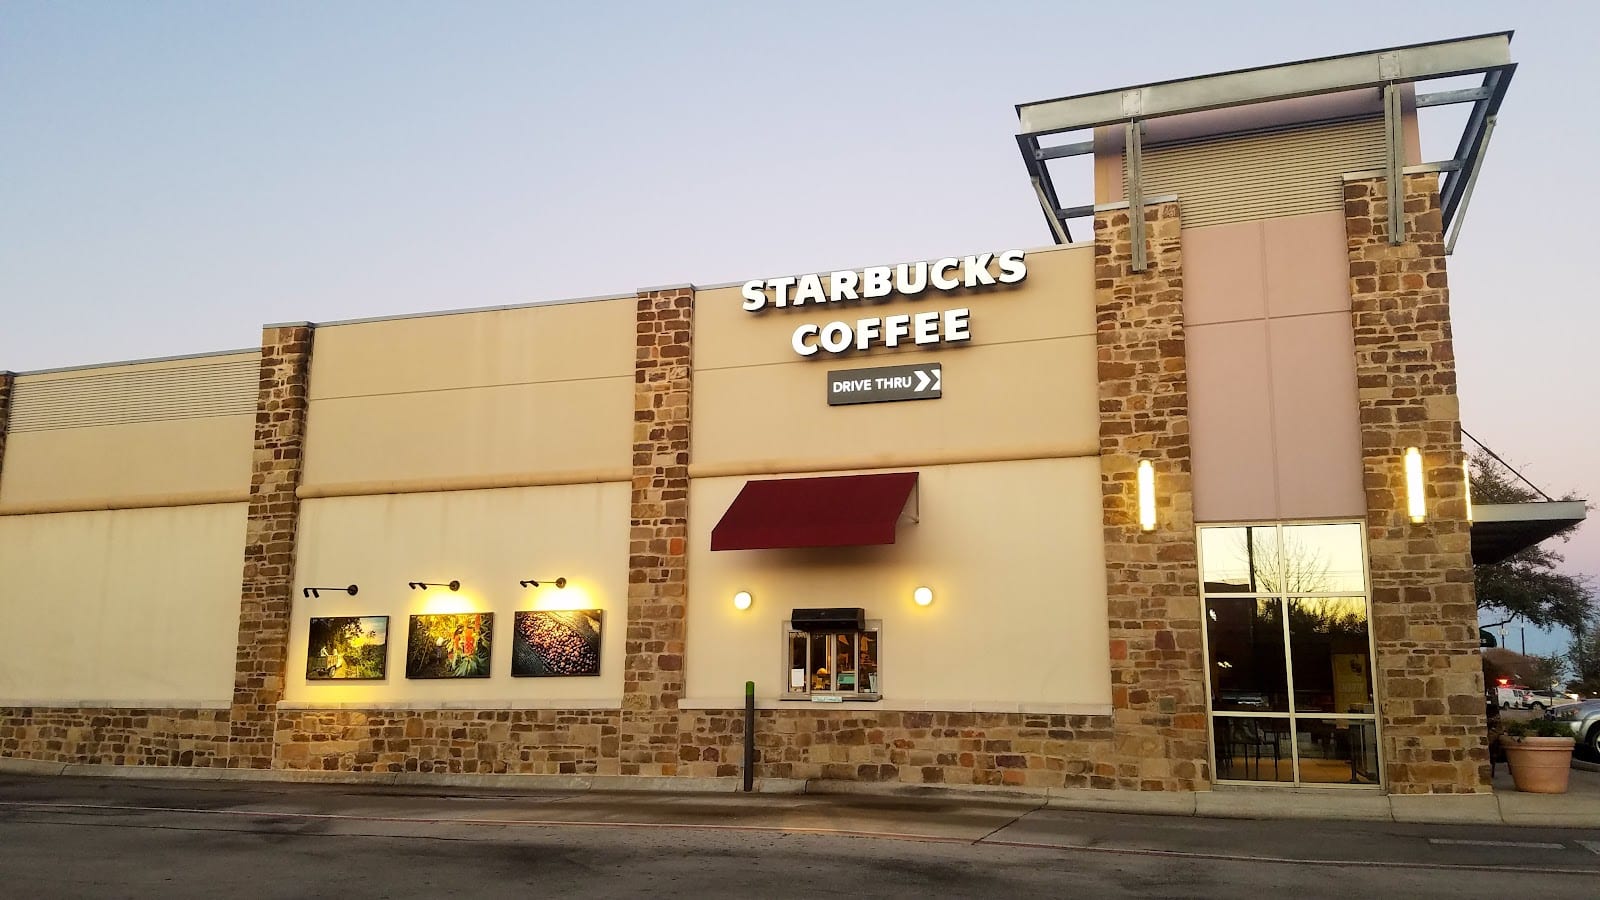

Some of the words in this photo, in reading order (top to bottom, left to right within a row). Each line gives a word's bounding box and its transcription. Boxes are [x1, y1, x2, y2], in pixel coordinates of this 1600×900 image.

[741, 250, 1028, 312] STARBUCKS
[791, 308, 971, 356] COFFEE
[833, 379, 872, 393] DRIVE
[875, 376, 912, 390] THRU
